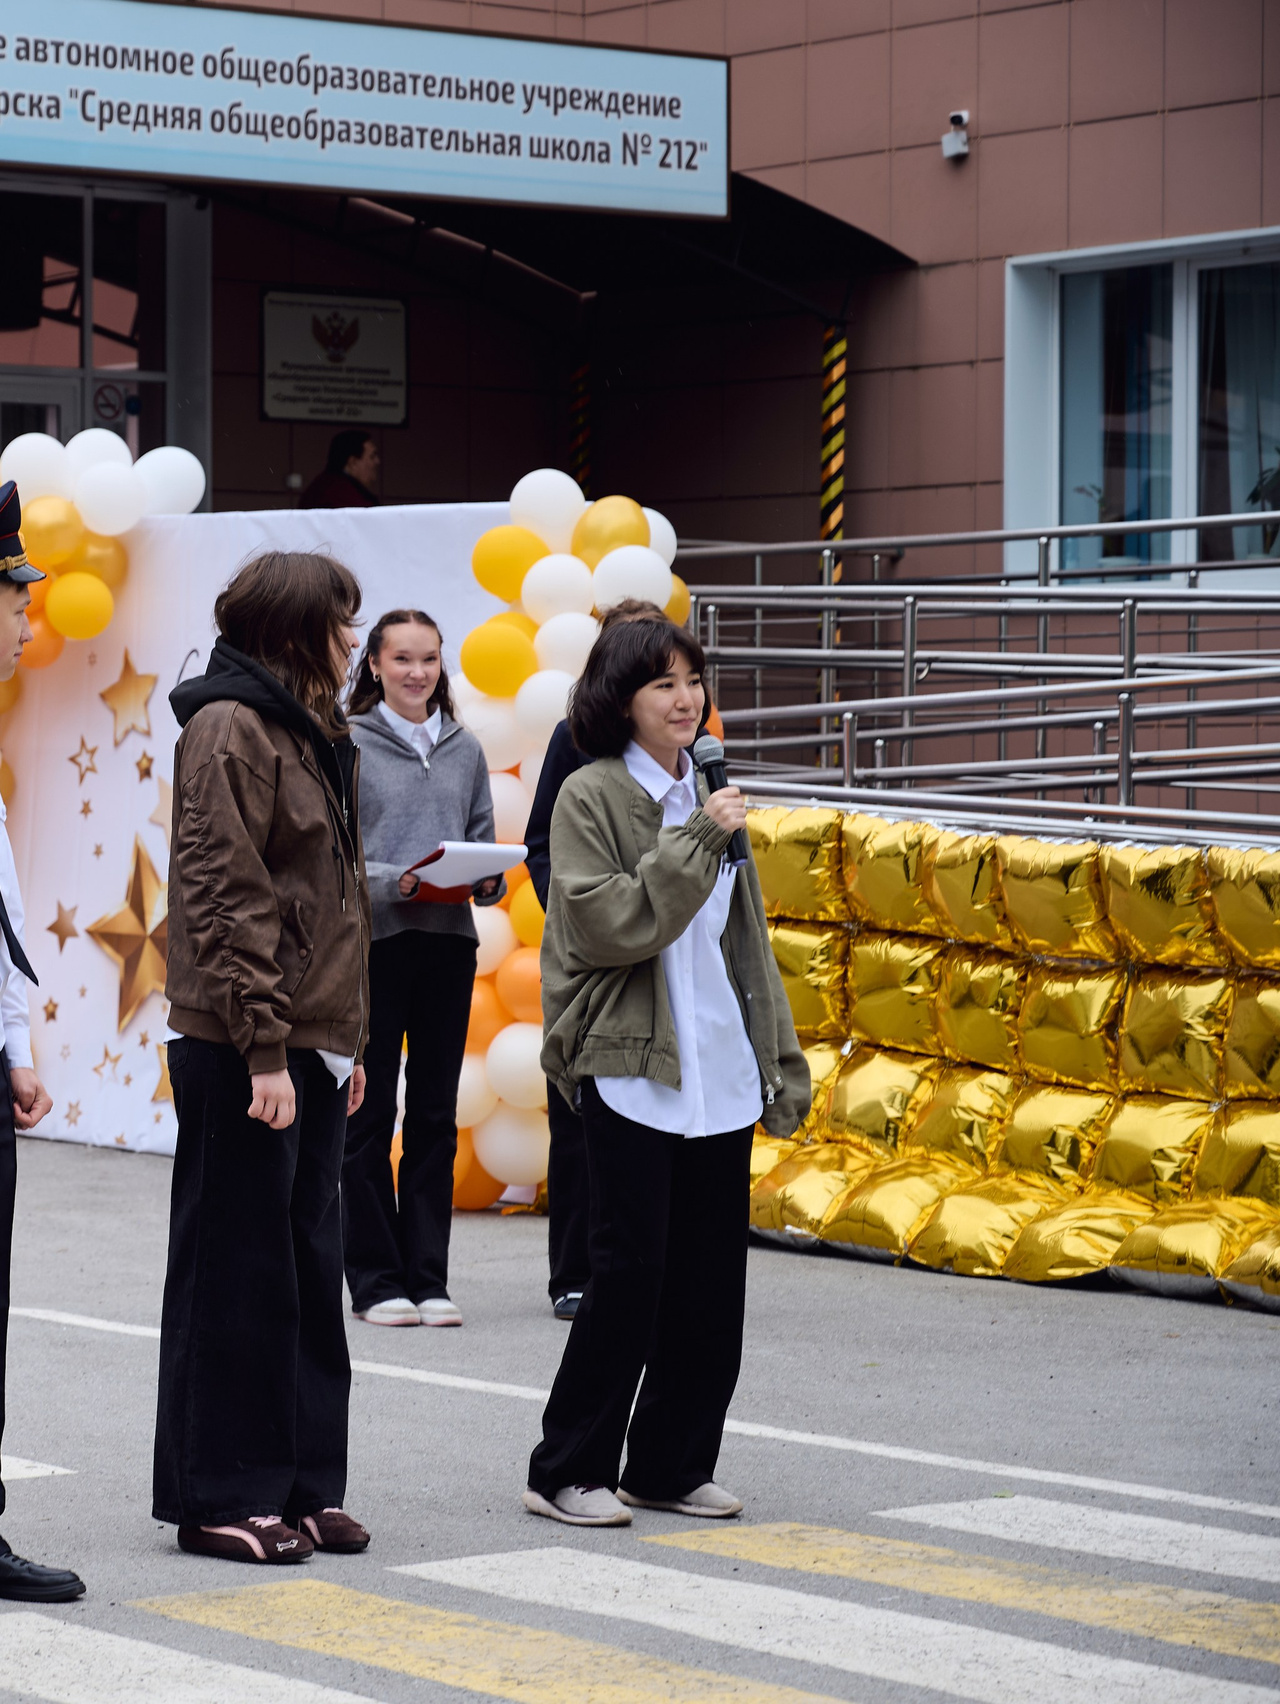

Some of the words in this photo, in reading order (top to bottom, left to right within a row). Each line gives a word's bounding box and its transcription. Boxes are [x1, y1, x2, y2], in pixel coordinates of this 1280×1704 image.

[15, 37, 194, 76] автономное
[202, 47, 515, 104] общеобразовательное
[522, 83, 682, 120] учреждение
[69, 89, 202, 133] "Средняя
[210, 102, 522, 156] общеобразовательная
[529, 136, 611, 164] школа
[622, 132, 652, 167] №
[658, 138, 708, 171] 212"
